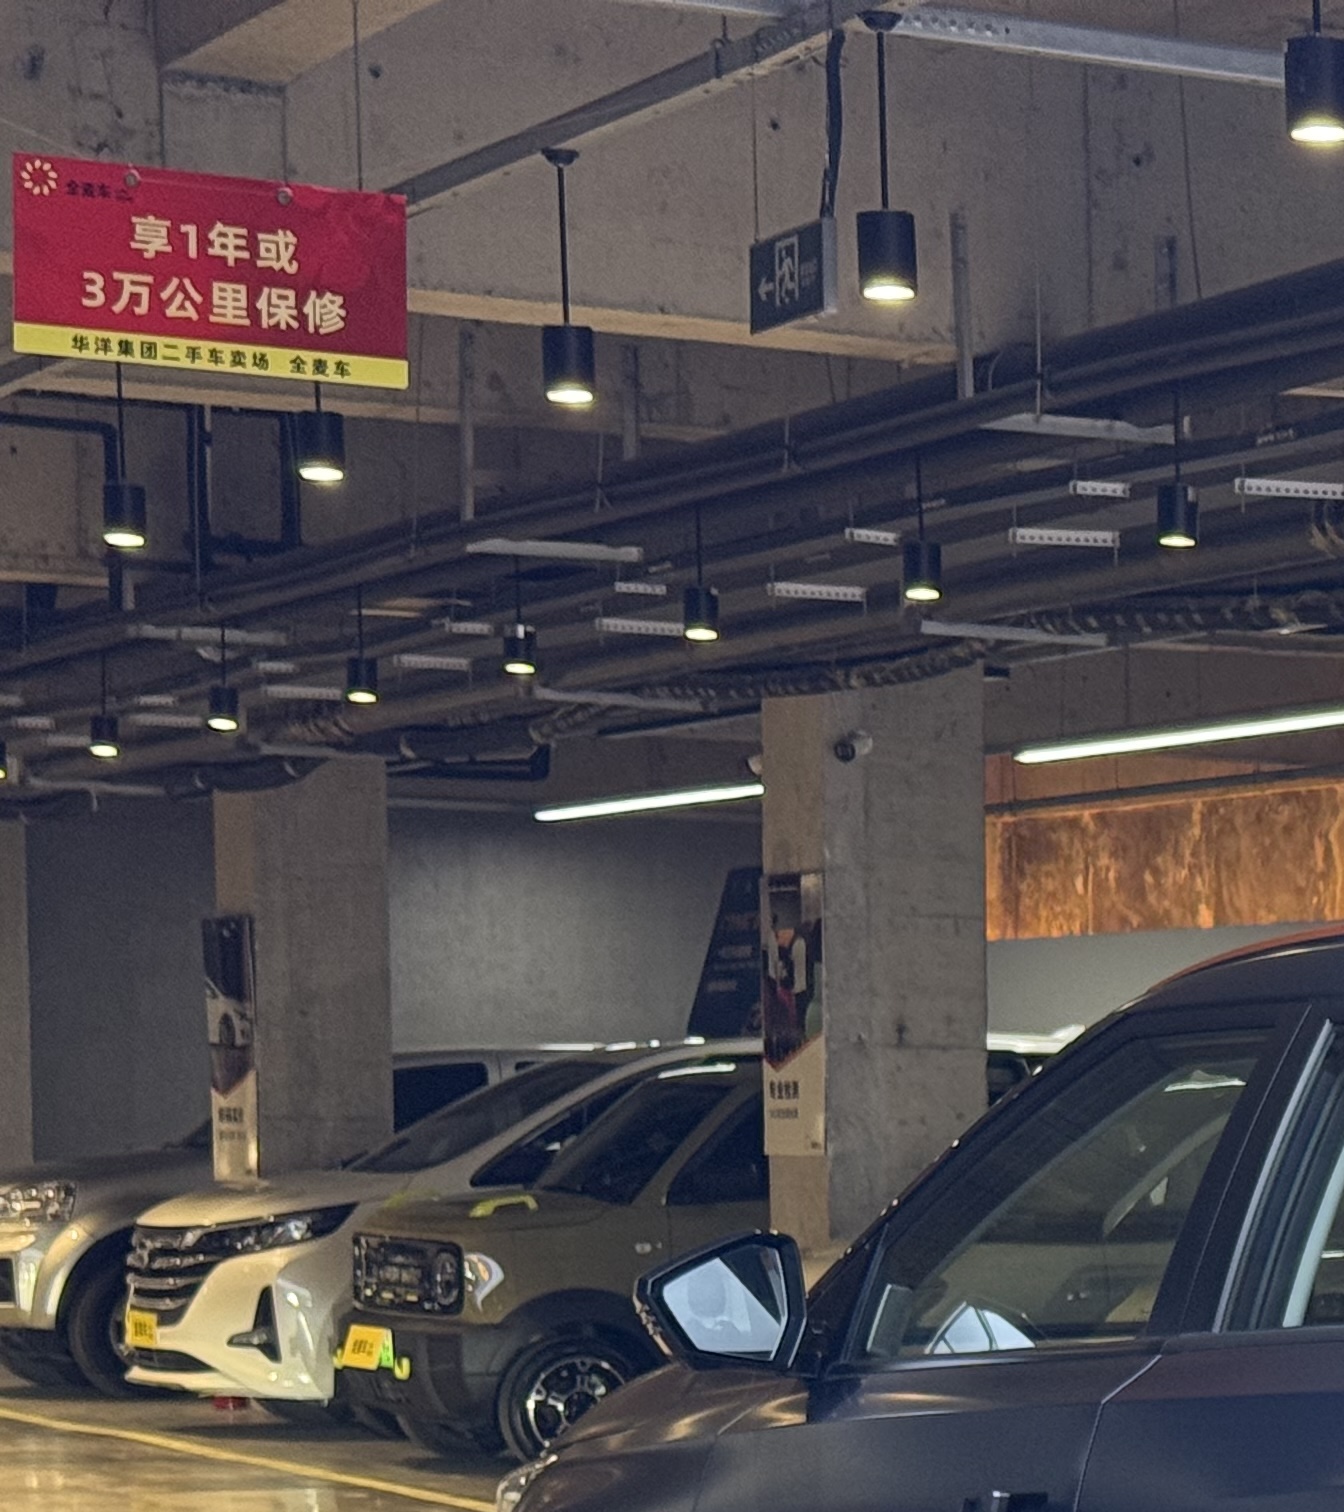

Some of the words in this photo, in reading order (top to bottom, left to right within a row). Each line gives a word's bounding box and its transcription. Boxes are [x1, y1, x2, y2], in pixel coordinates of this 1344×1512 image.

[130, 215, 299, 275] 享1年或
[81, 271, 347, 335] 3万公里保修
[71, 334, 270, 371] 华洋集团二手车卖场
[289, 355, 352, 379] 全麦车
